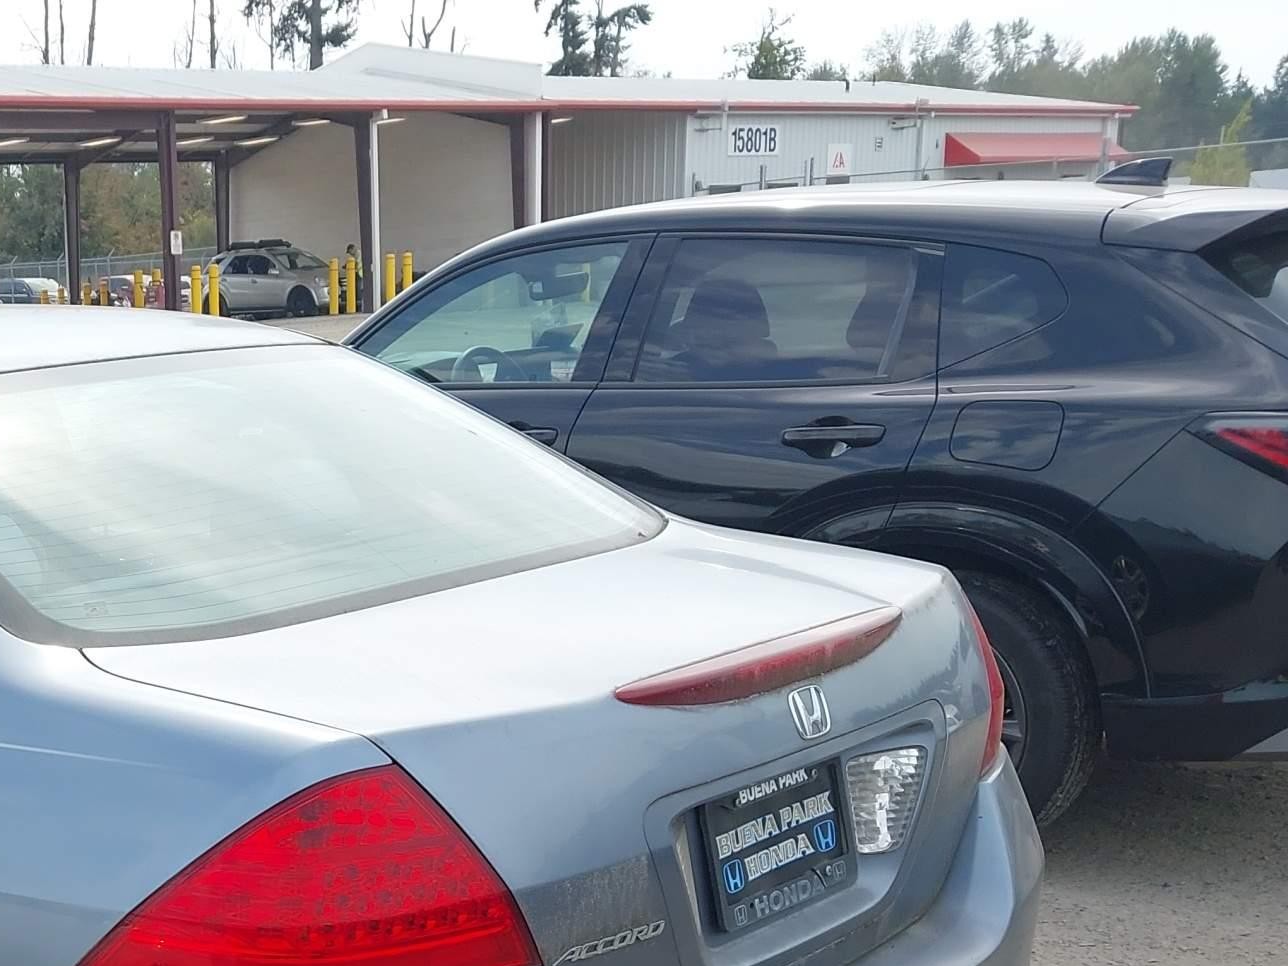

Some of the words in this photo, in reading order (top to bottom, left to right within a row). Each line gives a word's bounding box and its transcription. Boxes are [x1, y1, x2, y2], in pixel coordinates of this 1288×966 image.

[731, 127, 777, 153] 15801B
[739, 780, 777, 805] BUENA
[779, 768, 808, 789] PARK
[715, 814, 779, 860] BUENA
[779, 790, 835, 832] PARK
[744, 833, 815, 881] HONDA
[754, 873, 825, 918] HONDA
[552, 920, 665, 966] ACCORD
